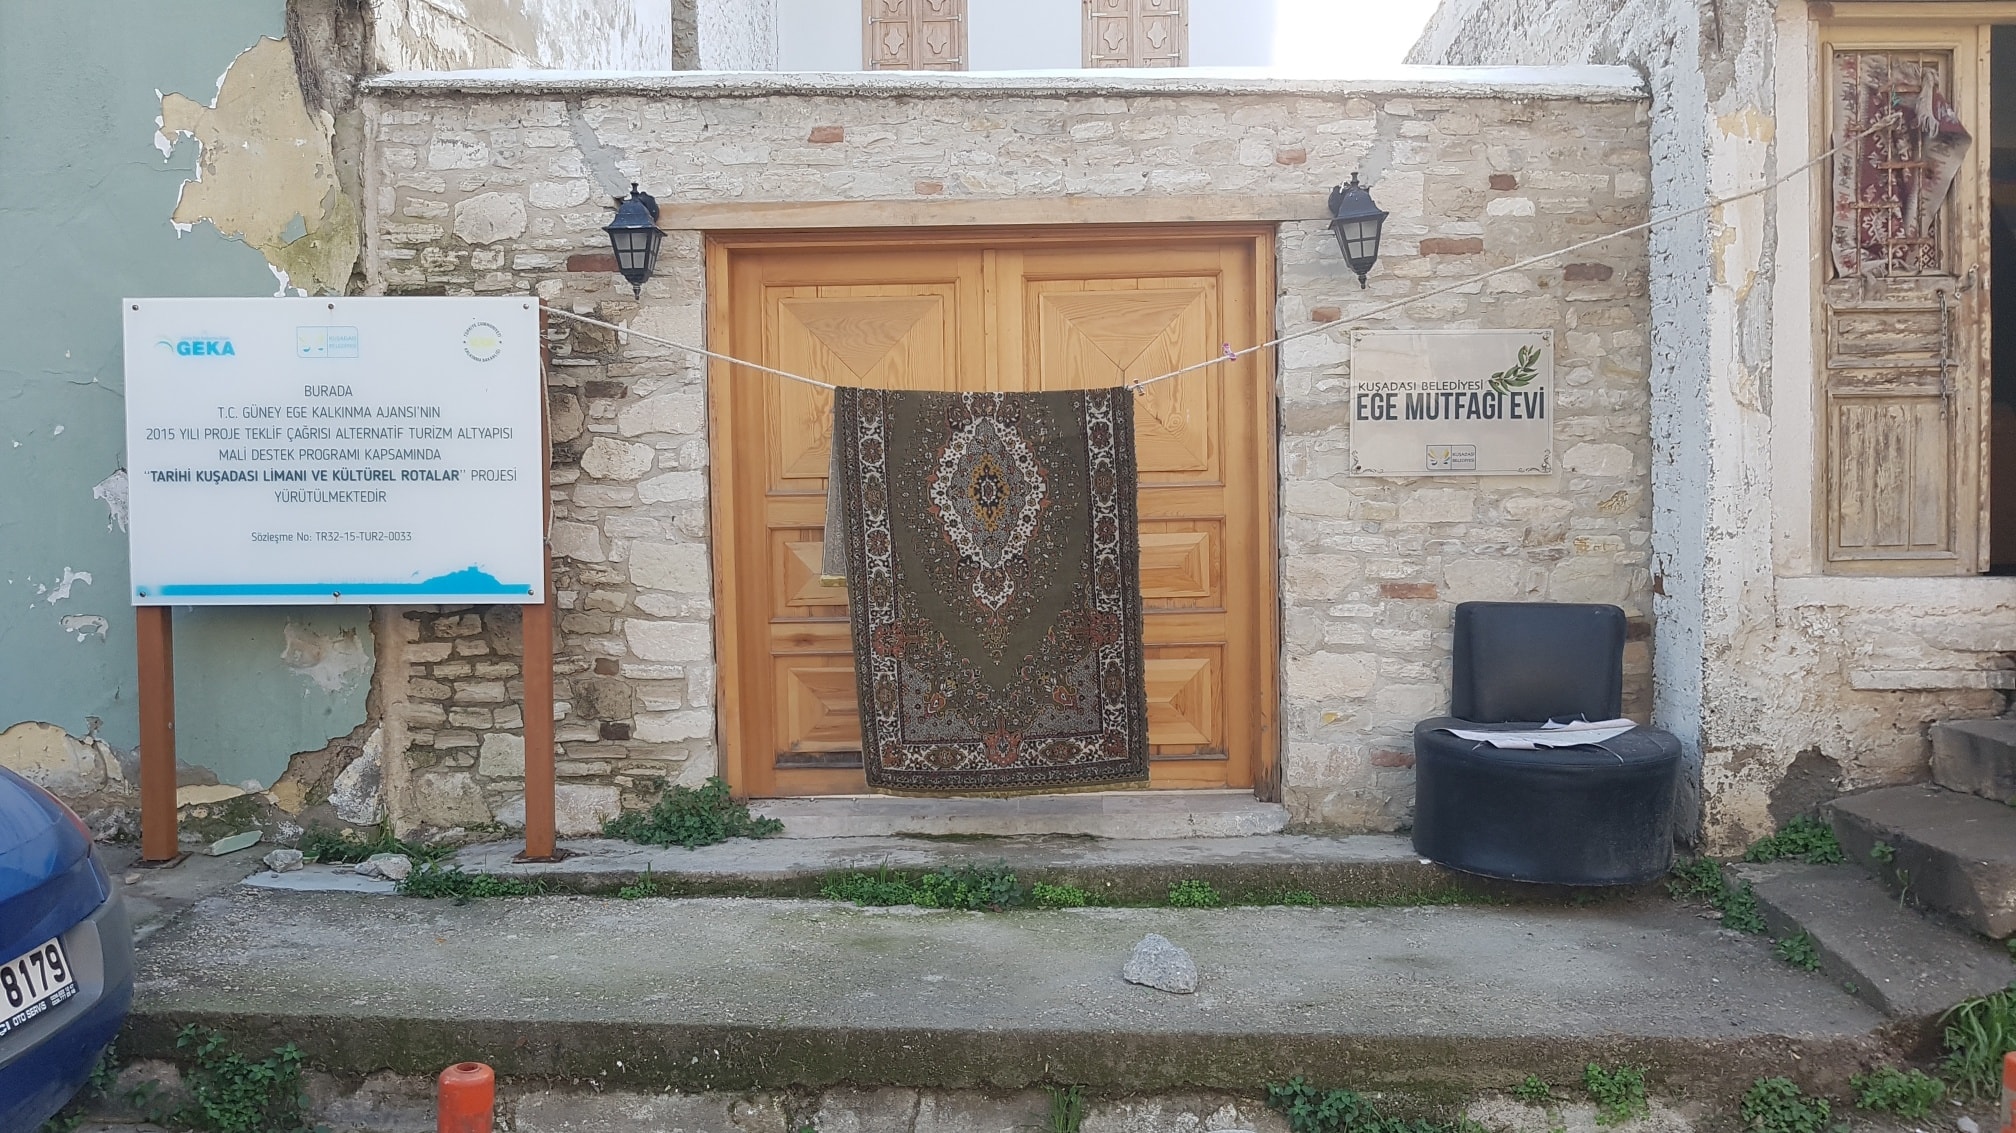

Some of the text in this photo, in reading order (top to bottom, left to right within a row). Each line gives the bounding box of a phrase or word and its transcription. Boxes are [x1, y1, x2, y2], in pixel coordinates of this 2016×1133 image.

[177, 340, 236, 356] GEKA
[304, 385, 353, 397] BURADA
[1358, 379, 1484, 393] KUŞADASI BELEDİYESİ
[1356, 386, 1545, 420] EGE MUTFAĞI EVİ
[217, 404, 441, 419] T.C. GÜNEY EGE KALKINMA AJANSI'NIN
[146, 425, 513, 443] 2015 YILI PROJE TEKLİF ÇAĞRISI ALTERNATİF TURİZM ALTYAPISI
[218, 446, 442, 461] MALİ DESTEK PROGRAMI KAPSAMINDA
[196, 470, 259, 484] KUŞADASI
[263, 467, 307, 482] LİMANI
[311, 470, 329, 482] VE
[332, 467, 397, 482] KÜLTÜREL
[471, 467, 518, 482] PROJESİ
[274, 488, 387, 503] YÜRÜTÜLMEKTEDİR
[251, 531, 412, 544] Sözleşme No: TR32-15-TUR2-0033
[0, 944, 66, 1008] 8179
[12, 1012, 27, 1027] OTO
